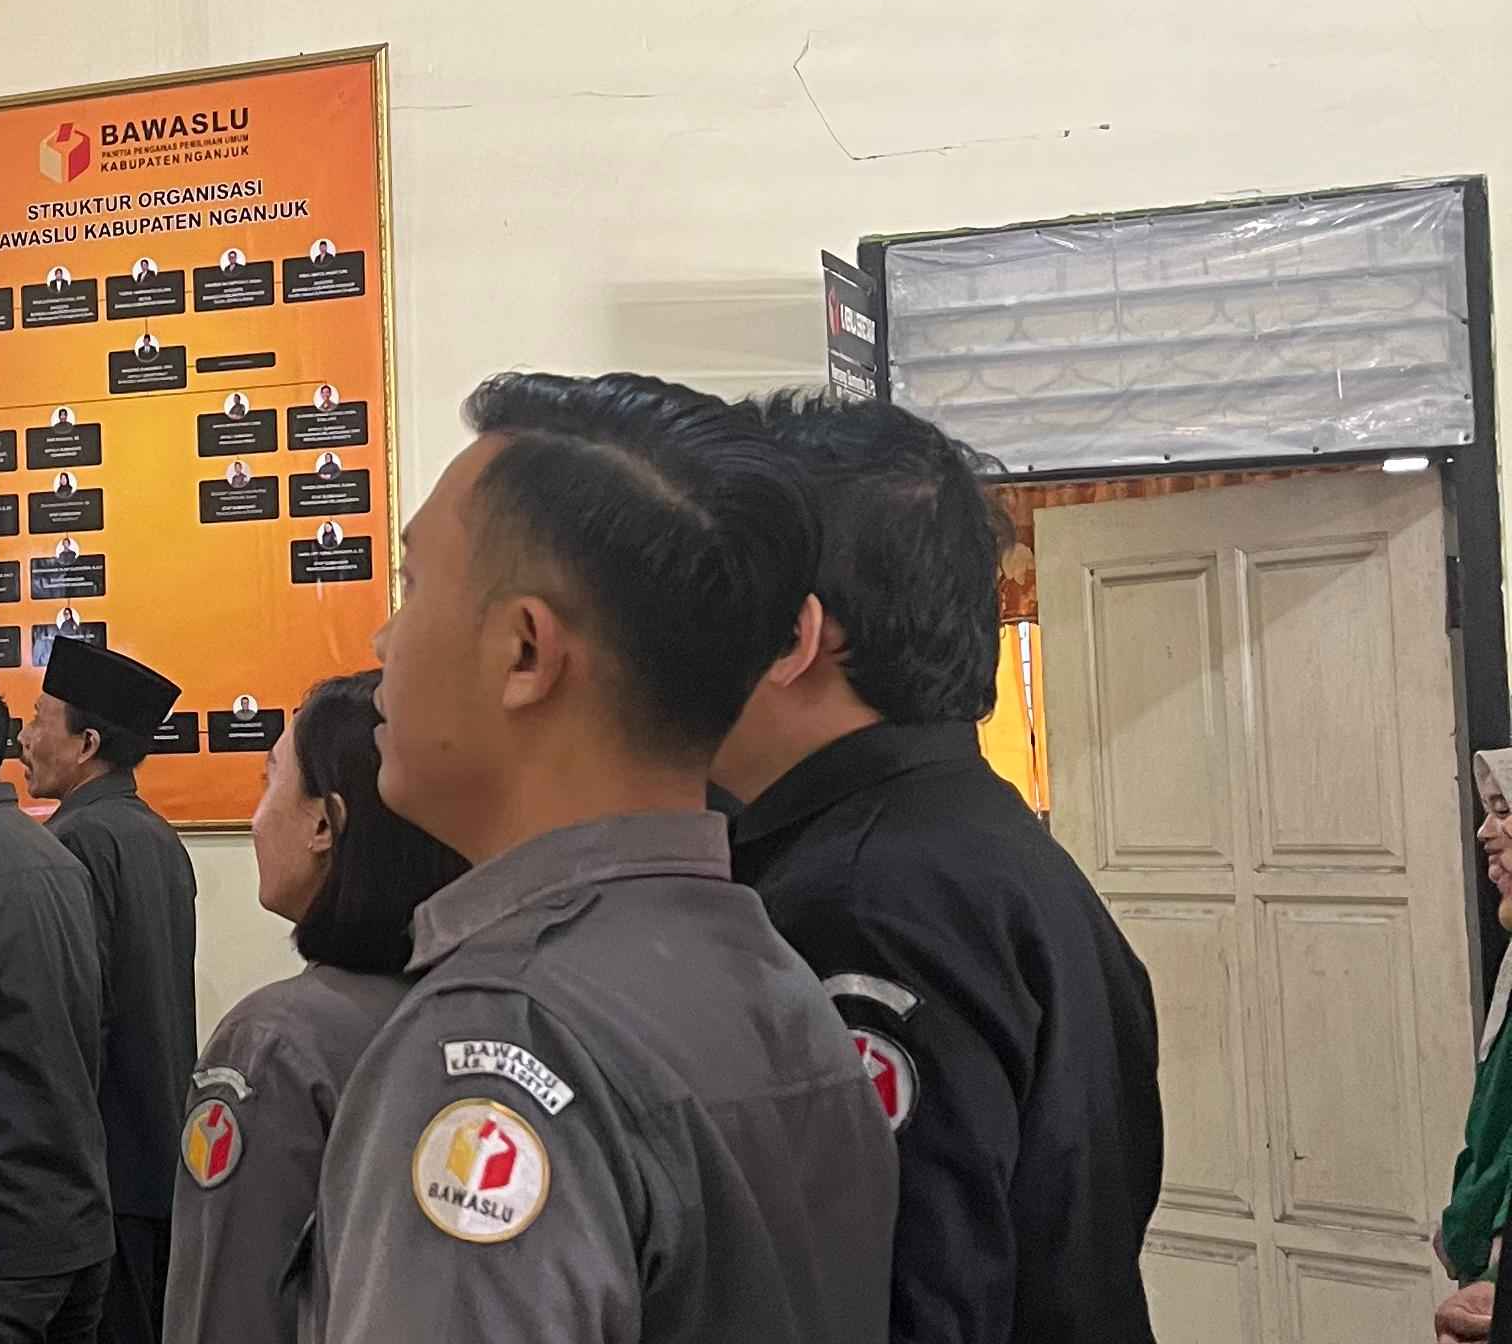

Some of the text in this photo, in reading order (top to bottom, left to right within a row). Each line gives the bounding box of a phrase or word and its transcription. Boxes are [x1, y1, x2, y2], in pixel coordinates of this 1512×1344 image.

[101, 107, 249, 146] BAWASLU
[100, 145, 249, 173] KABUPATEN NGANJUK
[27, 179, 263, 221] STRUKTUR ORGANISASI
[83, 213, 203, 240] KABUPATEN
[208, 199, 309, 227] NGANJUK
[463, 1042, 560, 1089] BAWASLU
[428, 1182, 515, 1223] BAWASLU
